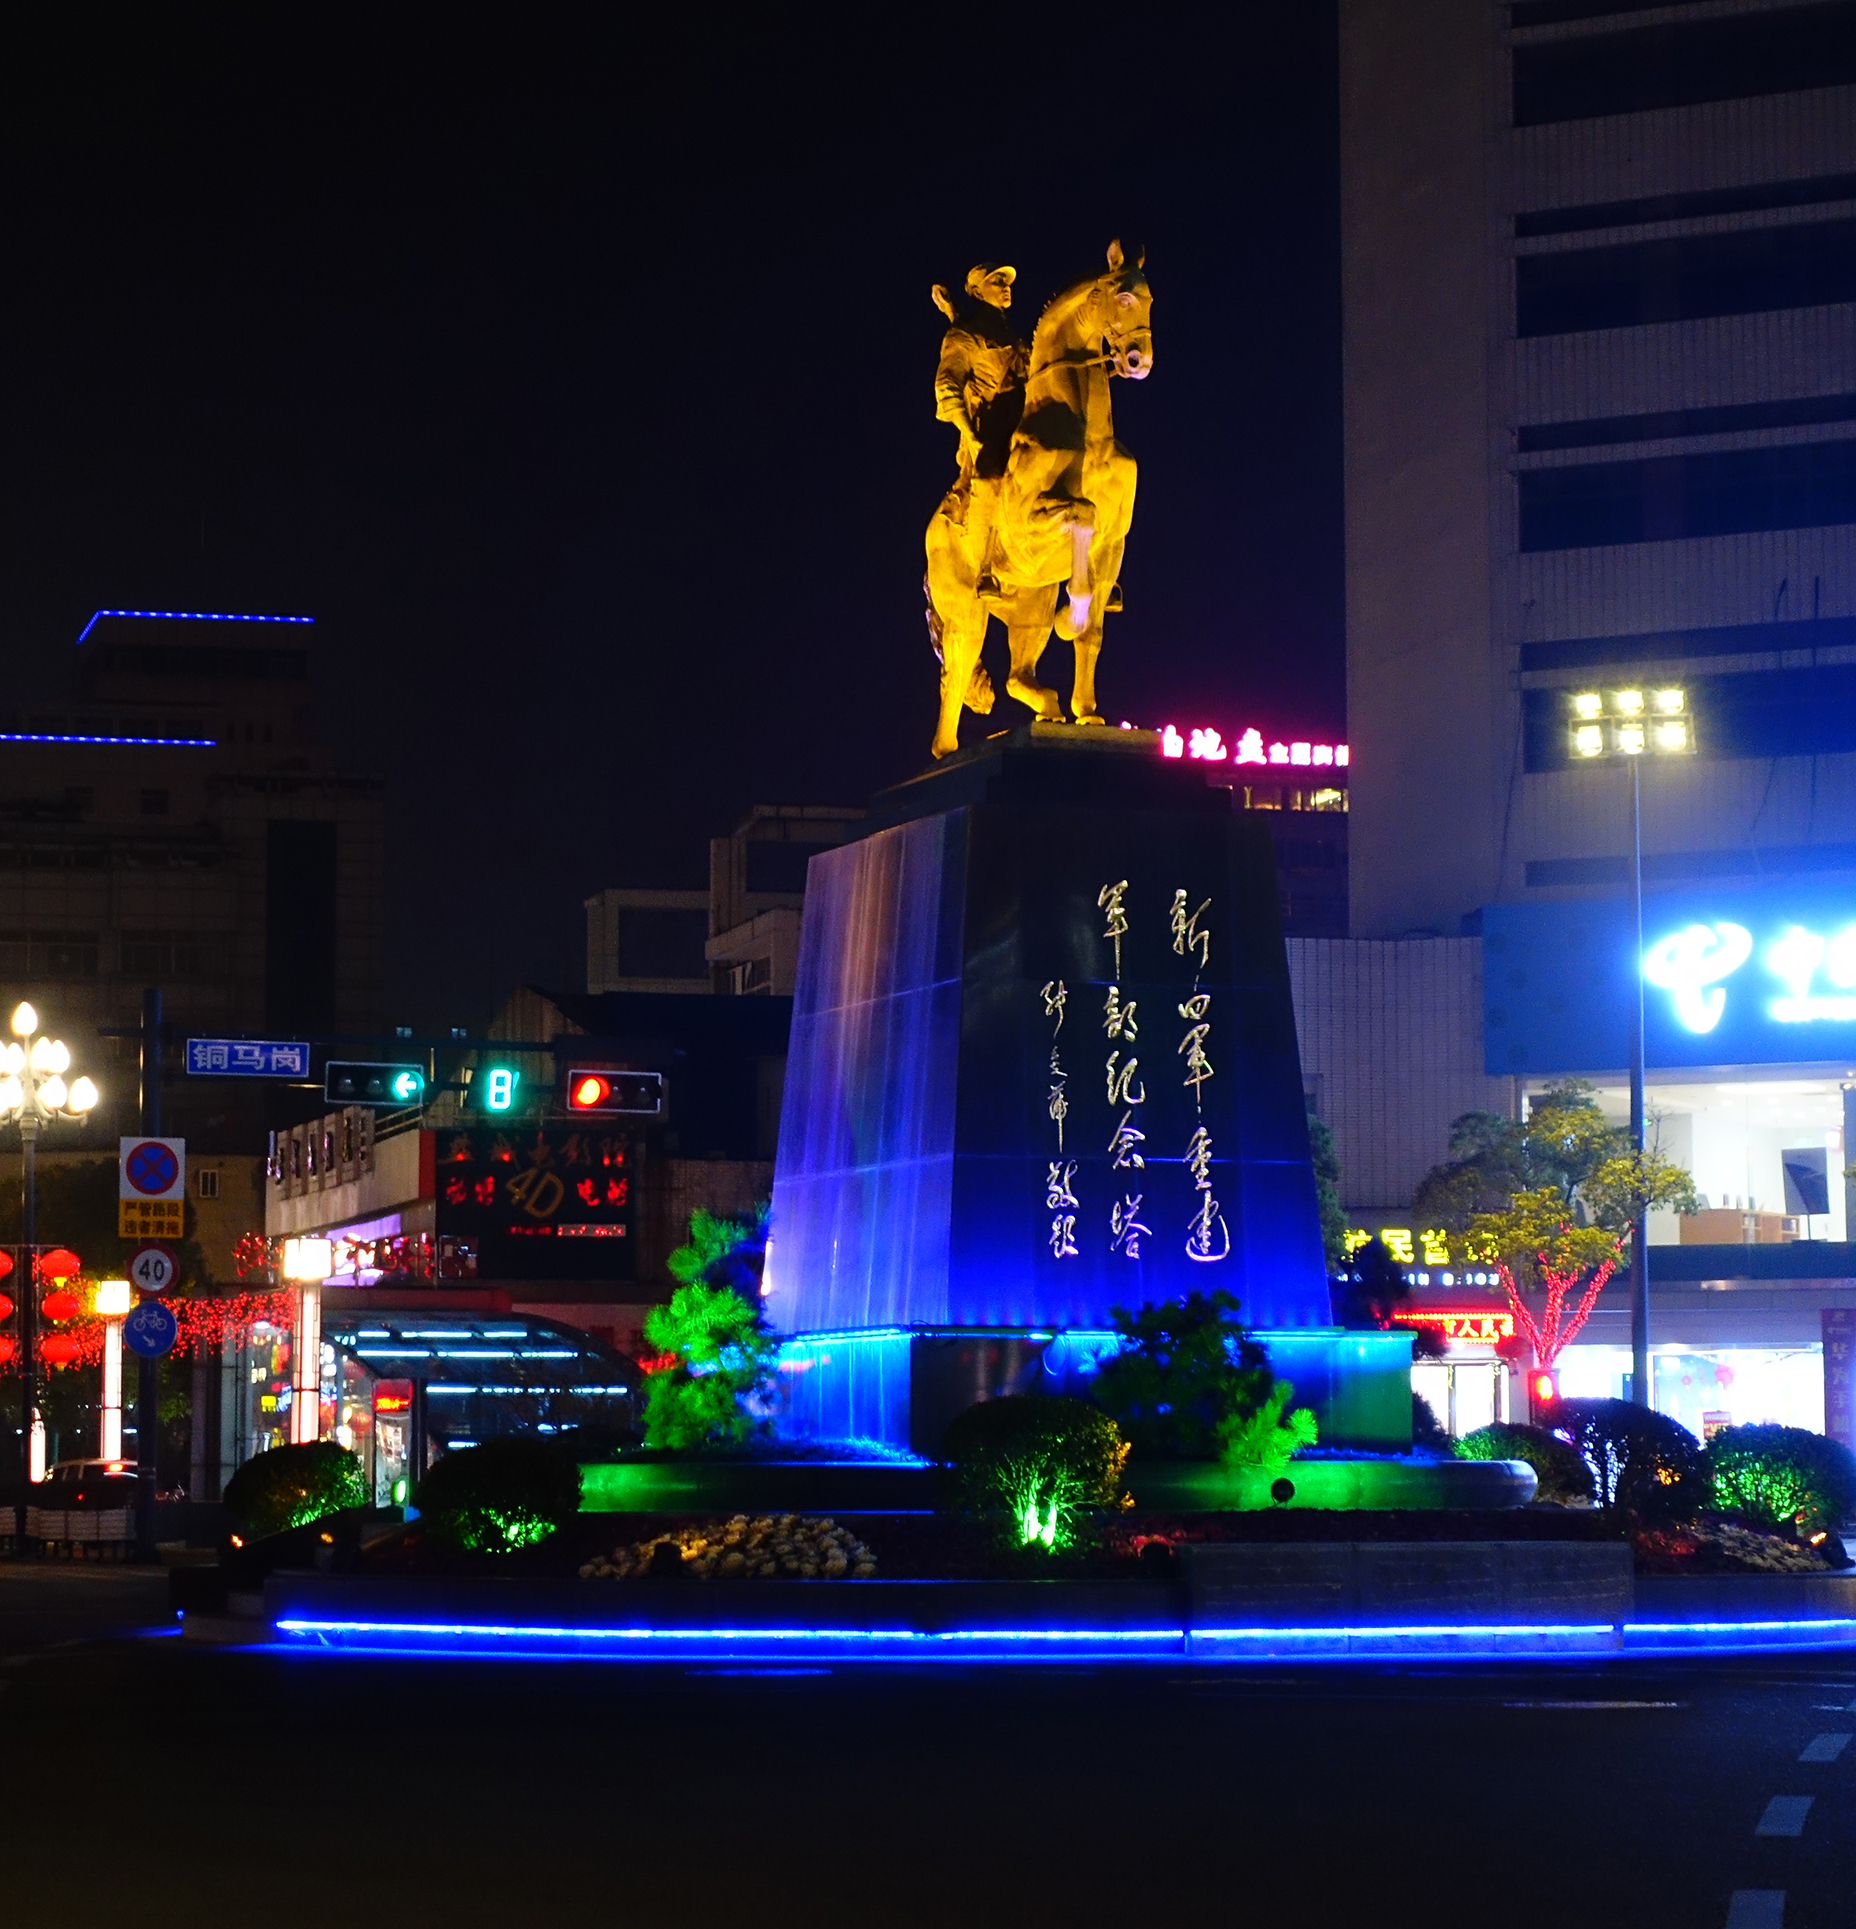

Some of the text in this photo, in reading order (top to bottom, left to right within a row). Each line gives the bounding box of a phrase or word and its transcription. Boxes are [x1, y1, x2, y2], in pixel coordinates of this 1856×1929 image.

[192, 1044, 302, 1073] 铜马岗
[488, 1068, 513, 1110] 8
[506, 1167, 564, 1218] 4D
[138, 1259, 165, 1282] 40
